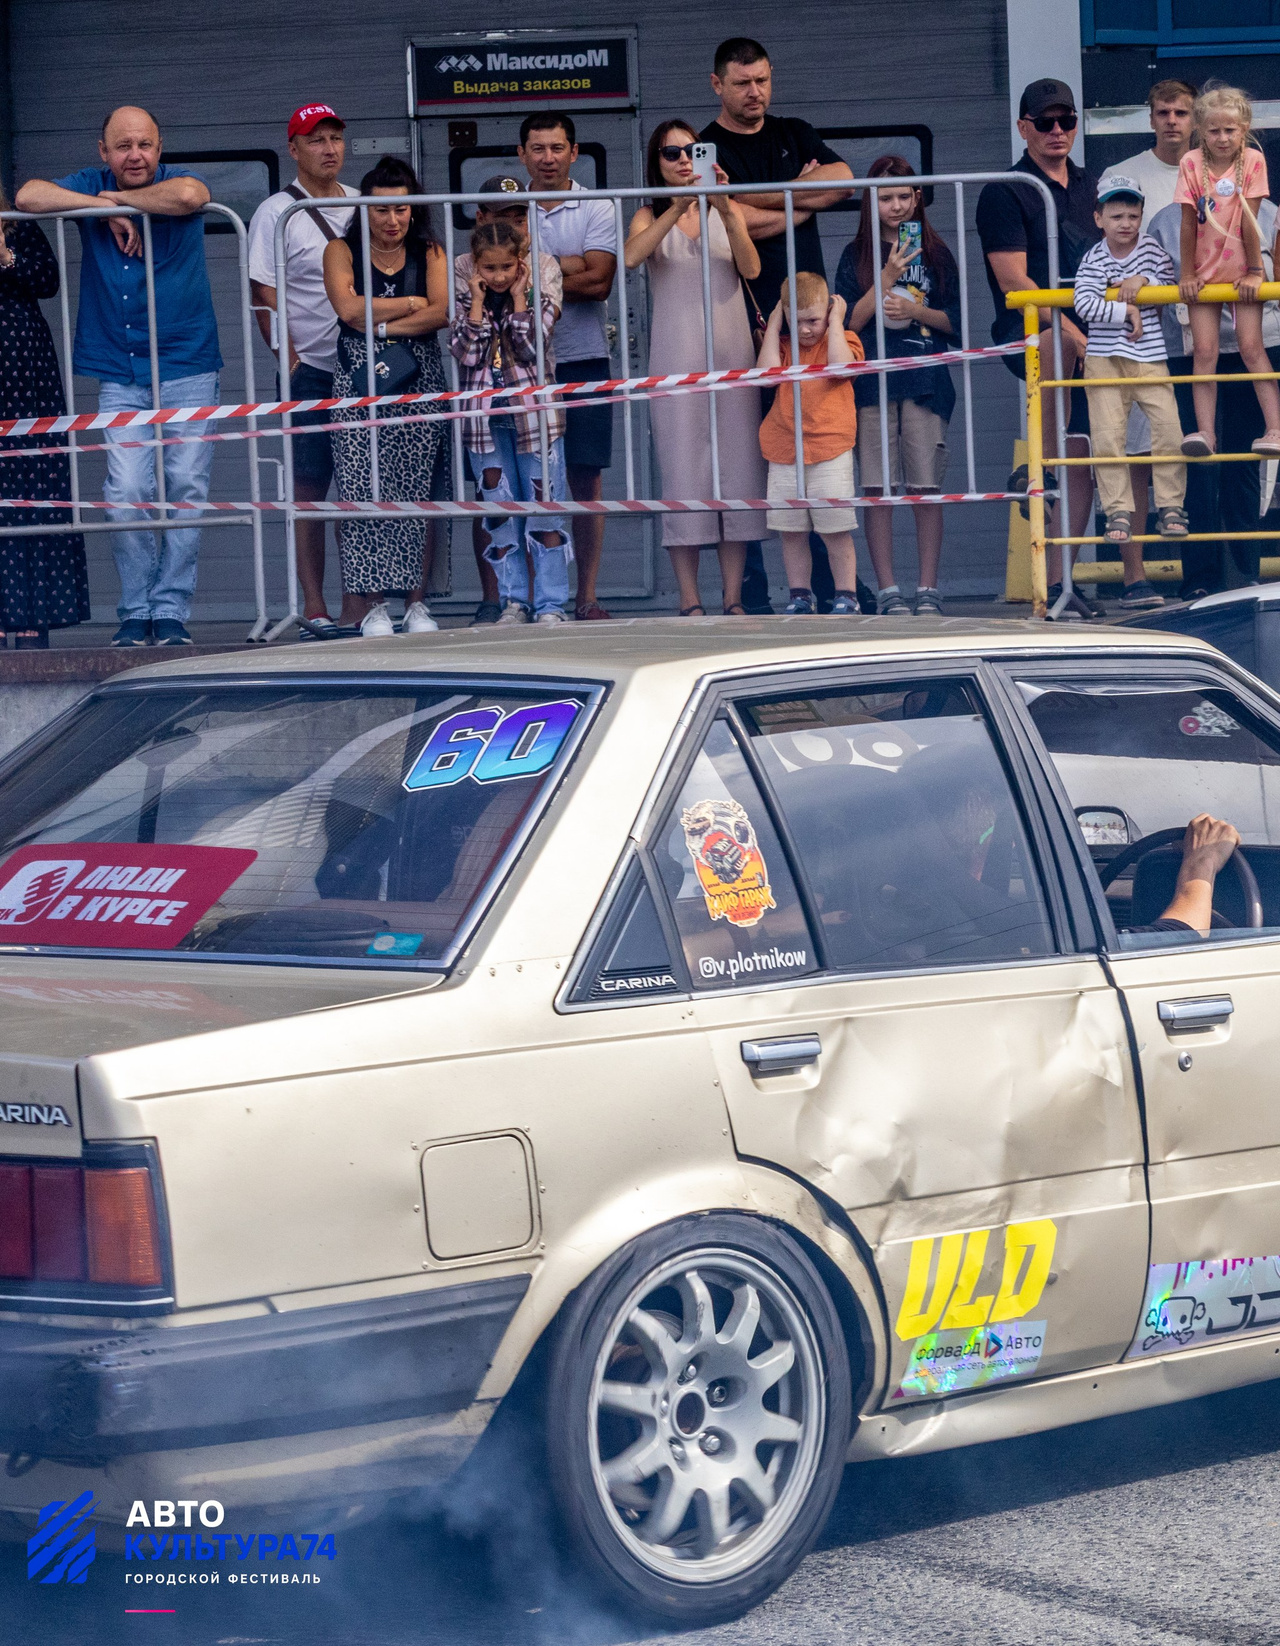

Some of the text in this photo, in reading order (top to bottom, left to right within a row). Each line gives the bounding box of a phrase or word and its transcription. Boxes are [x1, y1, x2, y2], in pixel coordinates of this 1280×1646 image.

[487, 49, 609, 71] МаксидоМ
[453, 79, 592, 95] Выдача заказов
[402, 698, 586, 792] 60
[75, 865, 187, 893] ЛЮДИ
[47, 895, 84, 920] В
[75, 896, 189, 926] КУРСЕ
[704, 886, 776, 919] КАЙФ ГАРАЖ
[601, 974, 677, 992] CARINA
[1004, 1335, 1042, 1351] Авто
